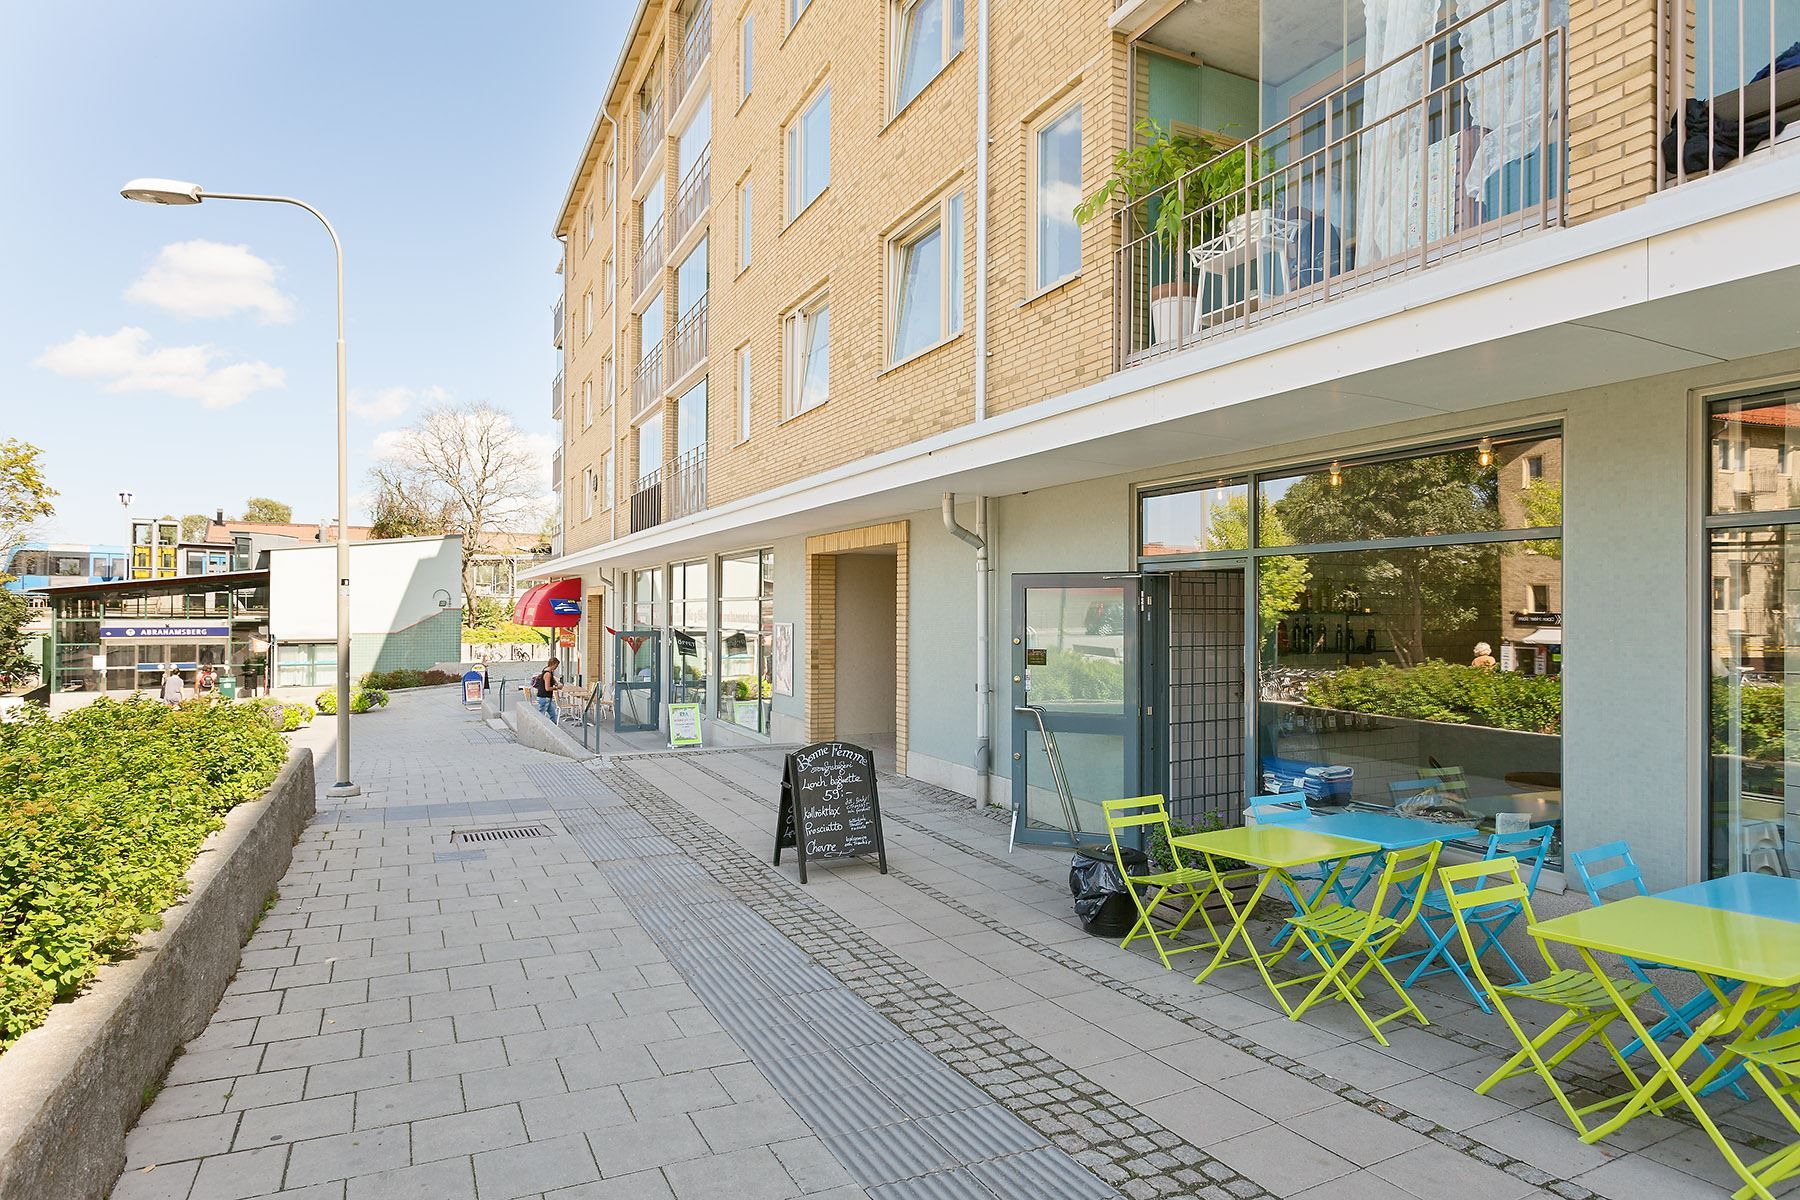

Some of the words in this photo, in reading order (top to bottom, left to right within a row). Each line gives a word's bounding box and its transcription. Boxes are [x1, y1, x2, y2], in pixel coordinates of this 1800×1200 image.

[140, 628, 207, 636] ABRAHAMSBERG
[797, 746, 830, 772] Bonne
[827, 743, 868, 767] Femme
[830, 774, 863, 790] baguette
[804, 821, 844, 838] Prosciutto
